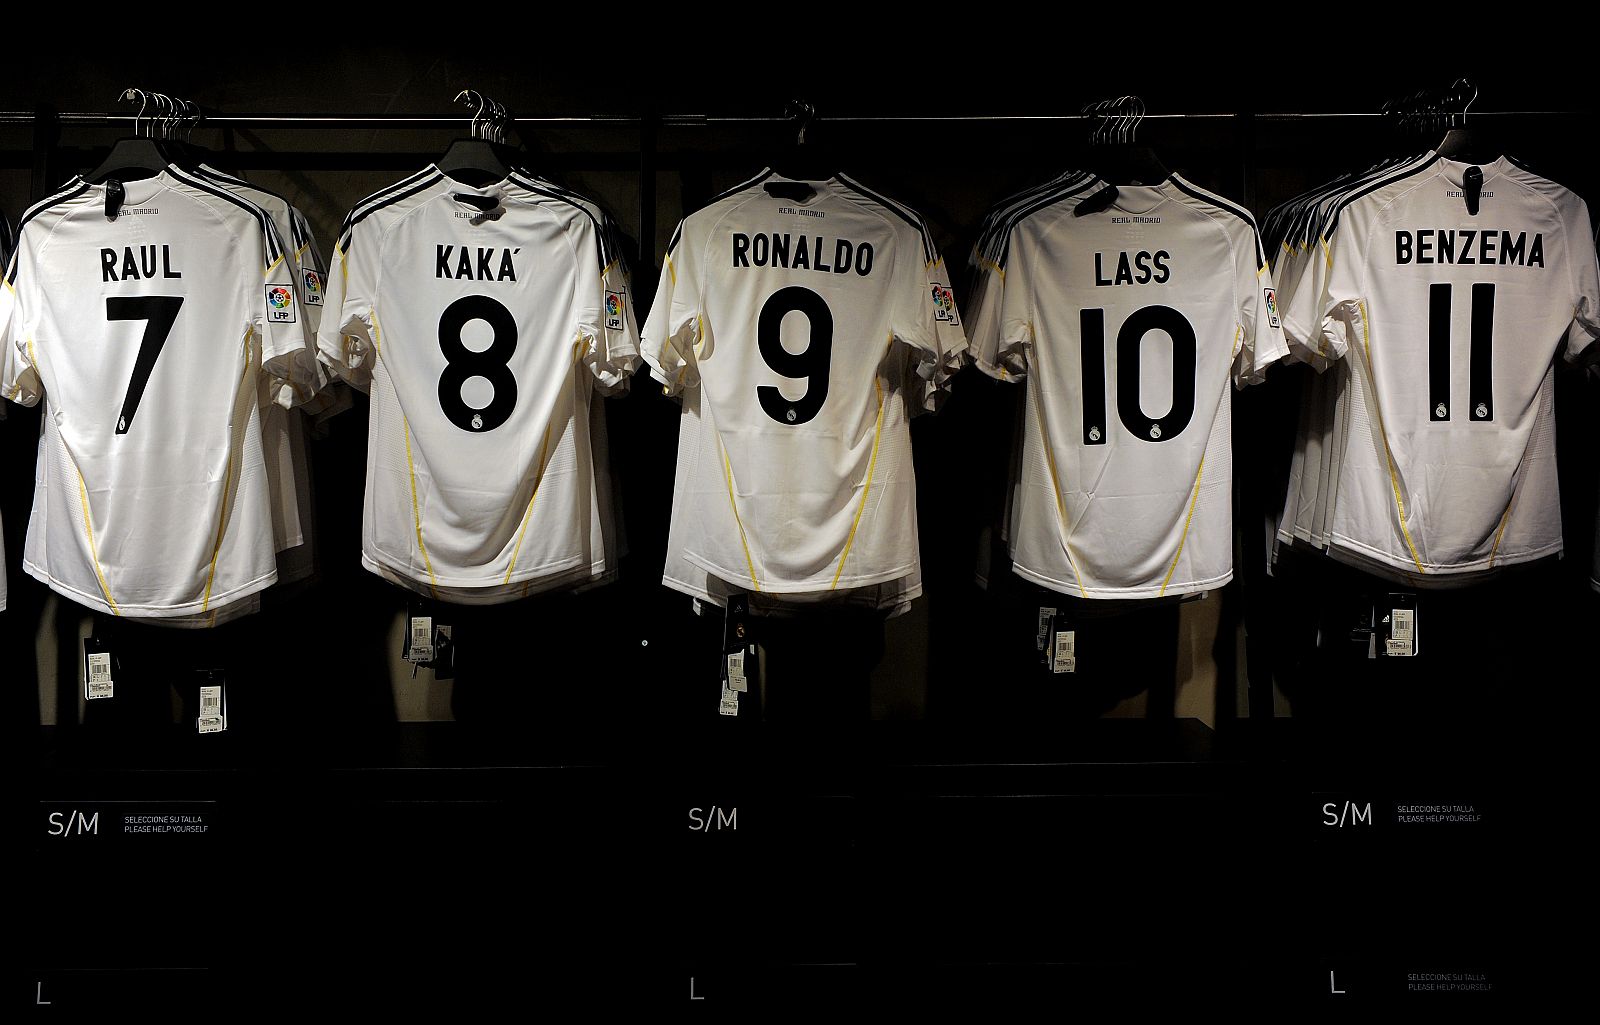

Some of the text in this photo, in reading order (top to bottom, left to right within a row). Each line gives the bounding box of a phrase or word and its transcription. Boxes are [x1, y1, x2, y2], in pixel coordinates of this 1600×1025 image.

[454, 211, 473, 219] REAL
[778, 207, 825, 218] REAL MADRID
[1132, 216, 1161, 224] MADRID
[732, 232, 874, 277] RONALDO
[1395, 229, 1545, 269] BENZEMA
[101, 244, 182, 283] RAUL
[1094, 249, 1171, 287] LASS
[105, 295, 185, 435] 7
[437, 294, 519, 433] 8
[756, 285, 834, 426] 9
[1428, 282, 1496, 422] 11
[1079, 304, 1198, 446] 10
[124, 815, 202, 824] SELECCIONE SU TALLA
[688, 805, 737, 833] S/M
[1322, 800, 1372, 828] S/M
[1397, 805, 1475, 813] SELECCIONE SU TALLA
[1398, 814, 1481, 823] PLEASE HELP YOURSELF
[47, 809, 99, 838] S/M
[124, 825, 209, 833] PLEASE HELP YOURSELF
[36, 981, 52, 1005] L
[690, 976, 705, 1000] L
[1330, 970, 1346, 994] L
